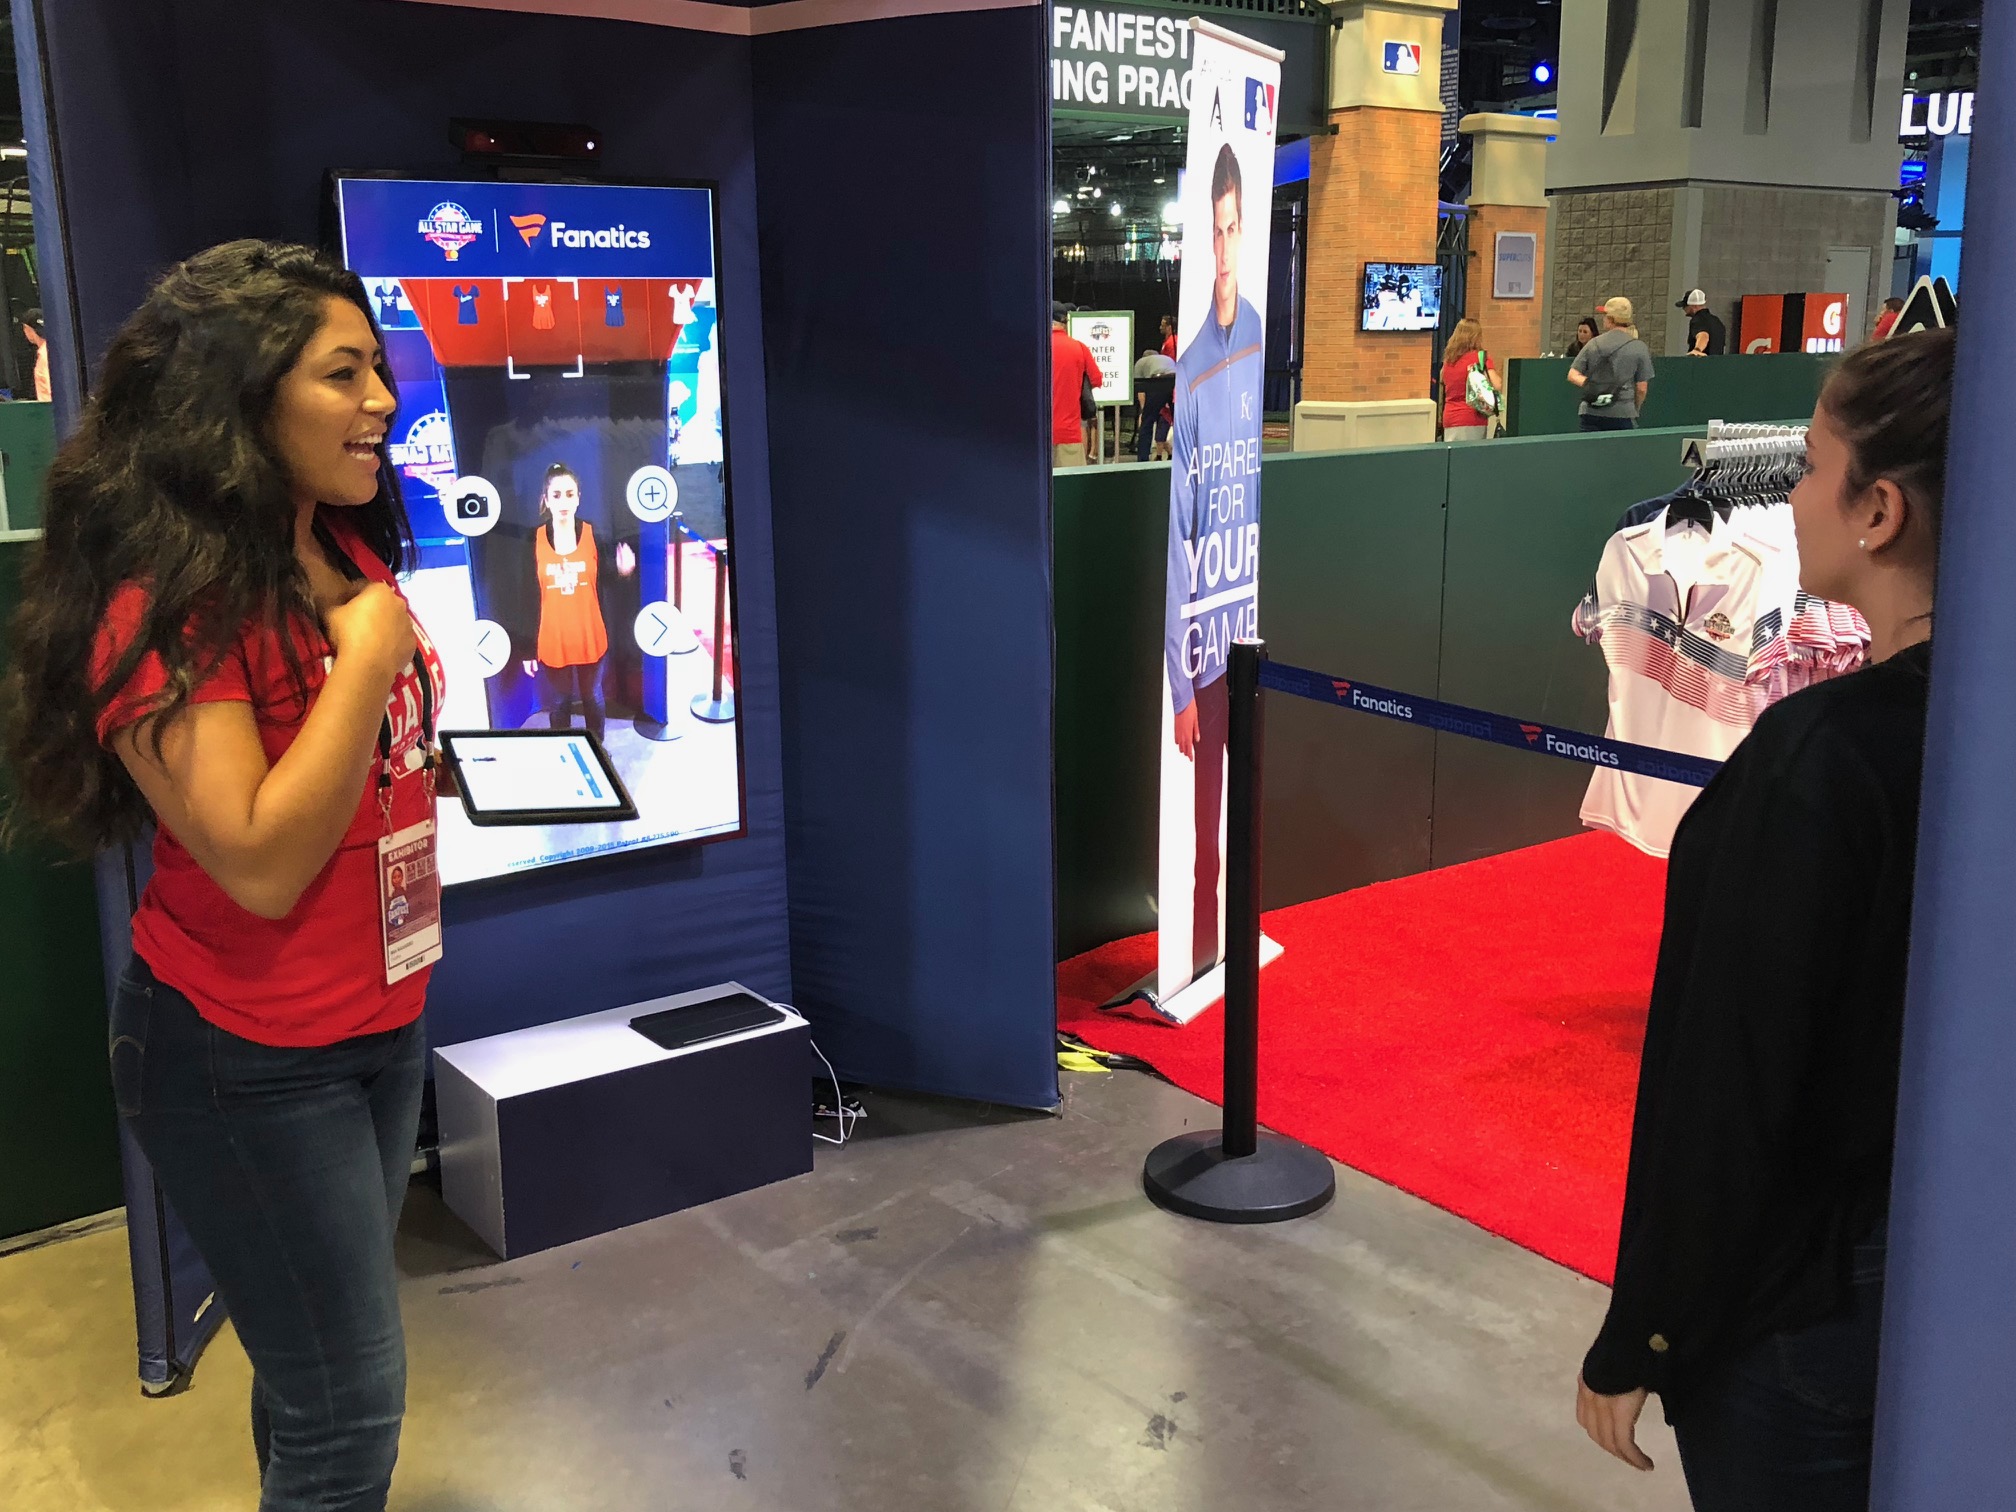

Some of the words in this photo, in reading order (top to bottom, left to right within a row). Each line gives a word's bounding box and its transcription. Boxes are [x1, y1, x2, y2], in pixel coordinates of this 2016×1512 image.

[1053, 6, 1191, 59] FANFEST
[418, 220, 435, 234] ALL
[435, 221, 458, 234] STAR
[459, 221, 482, 234] GAME
[551, 221, 651, 249] Fanatics
[1186, 436, 1261, 487] APPAREL
[1208, 484, 1245, 527] FOR
[1183, 522, 1259, 594] YOUR
[1353, 689, 1413, 719] Fanatics
[1546, 733, 1619, 766] Fanatics
[388, 838, 428, 862] EXHIBITOR
